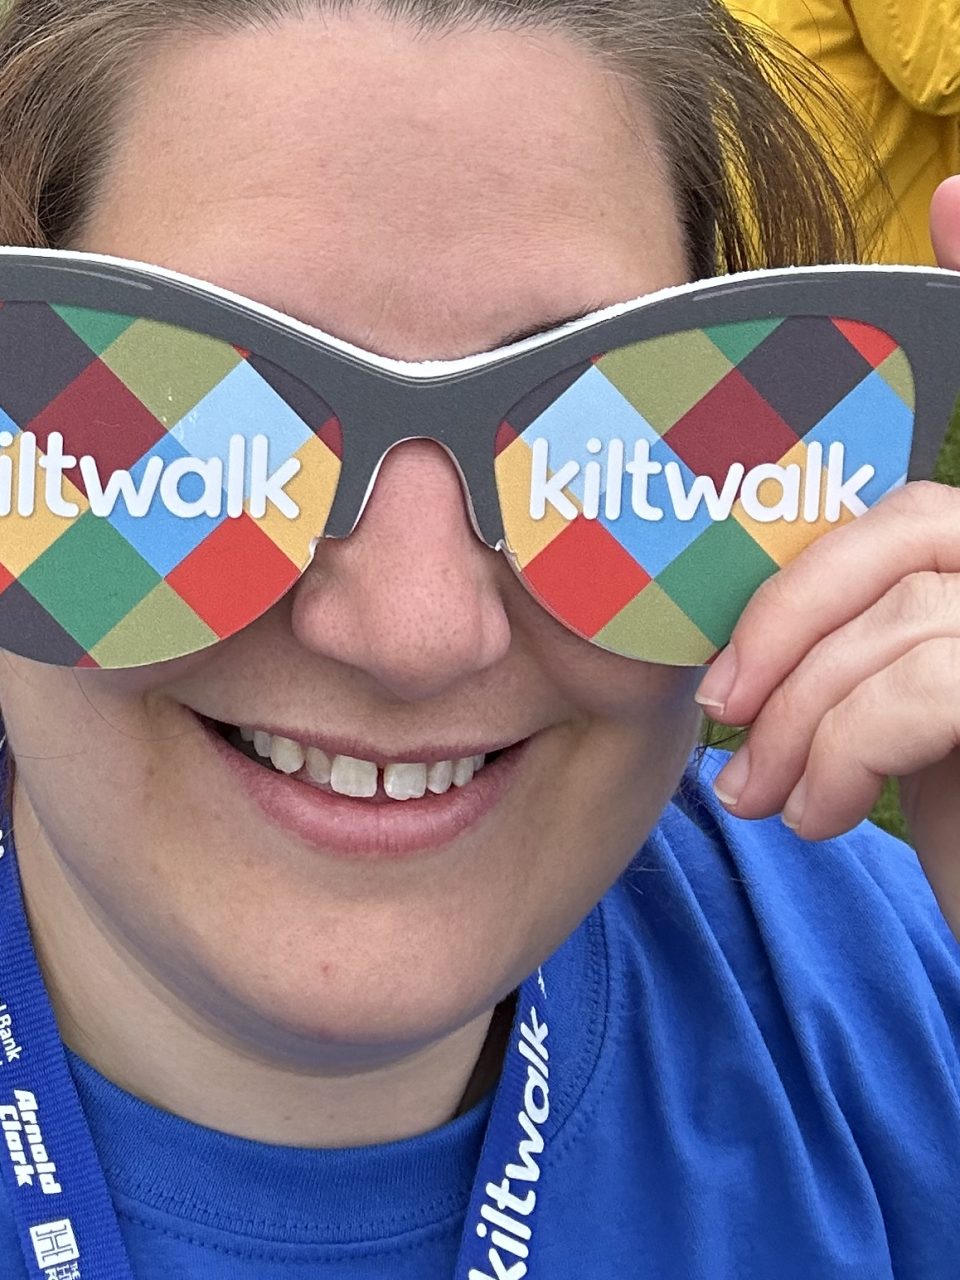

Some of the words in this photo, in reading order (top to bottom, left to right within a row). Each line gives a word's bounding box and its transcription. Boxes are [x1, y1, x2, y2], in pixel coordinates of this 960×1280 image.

[528, 438, 878, 523] kiltwalk
[13, 1089, 62, 1195] Arnold
[467, 1006, 550, 1280] kiltwalk
